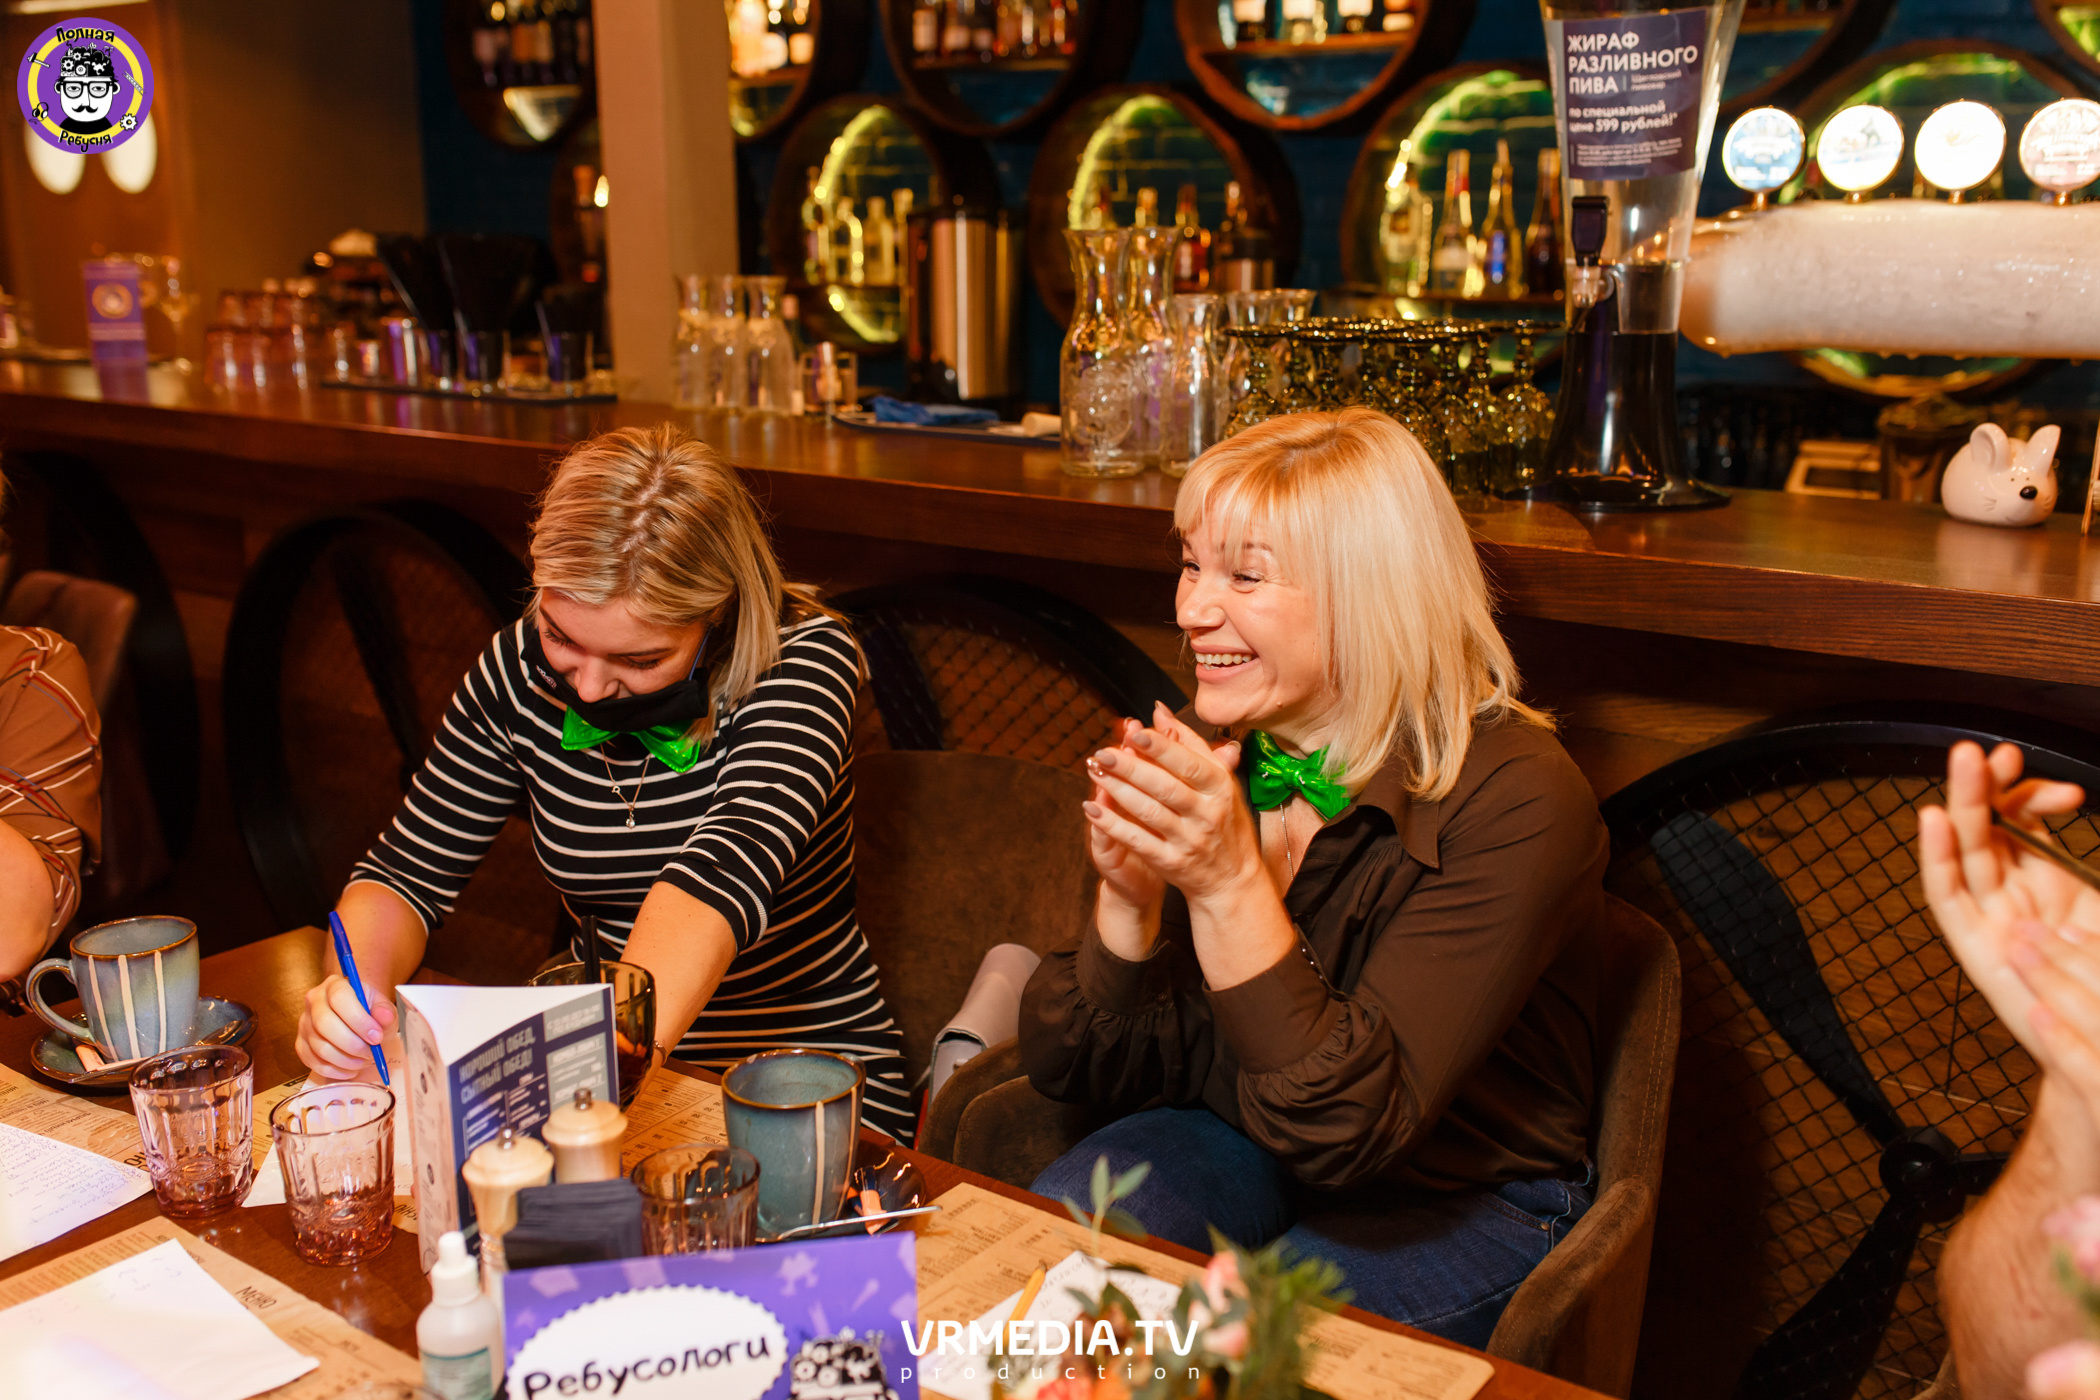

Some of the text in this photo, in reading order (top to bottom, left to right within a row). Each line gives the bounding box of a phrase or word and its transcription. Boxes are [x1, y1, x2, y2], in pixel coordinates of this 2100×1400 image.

[1567, 31, 1640, 53] ЖИРАФ
[1568, 45, 1698, 74] РАЗЛИВНОГО
[1568, 75, 1619, 95] ПИВА
[1568, 99, 1667, 119] по специальной
[1595, 117, 1620, 133] 599
[234, 1285, 278, 1310] МЕНЮ
[523, 1336, 771, 1400] Ребусологи
